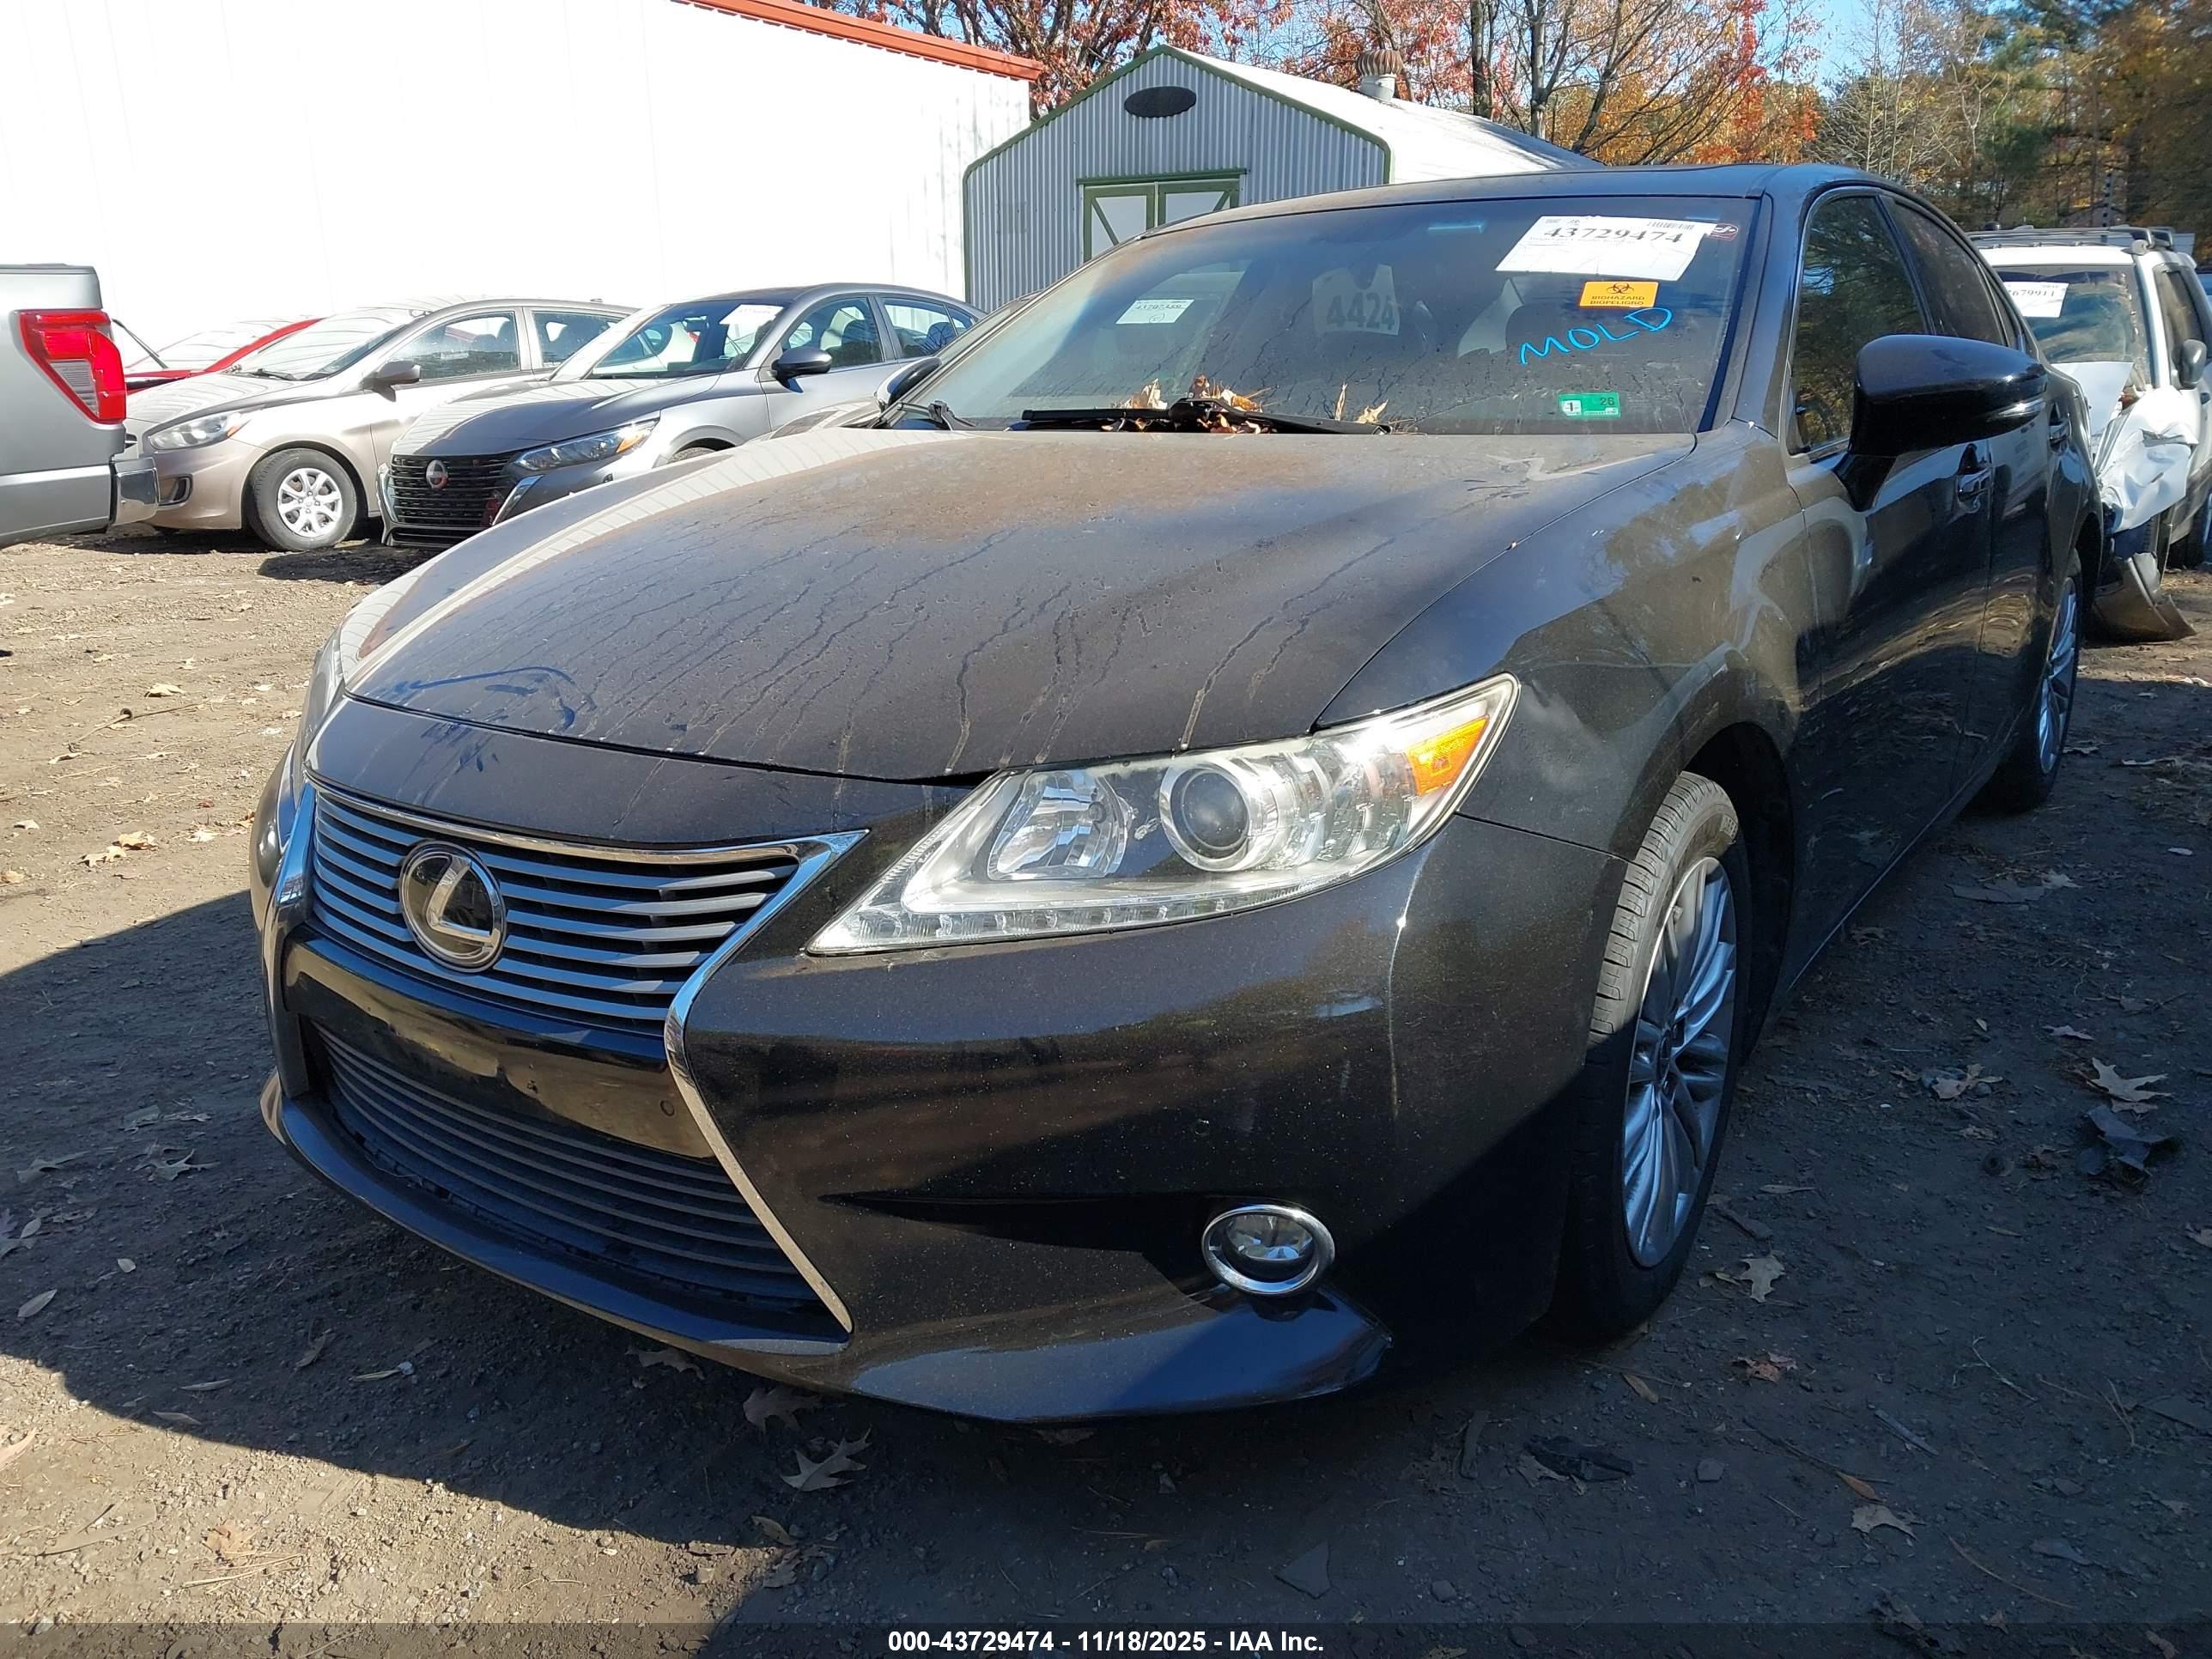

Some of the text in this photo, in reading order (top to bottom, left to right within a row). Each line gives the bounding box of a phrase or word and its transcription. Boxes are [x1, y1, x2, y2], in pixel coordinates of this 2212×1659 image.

[1544, 227, 1683, 243] 43729474
[1519, 307, 1674, 365] MOLD
[1600, 397, 1615, 406] 26
